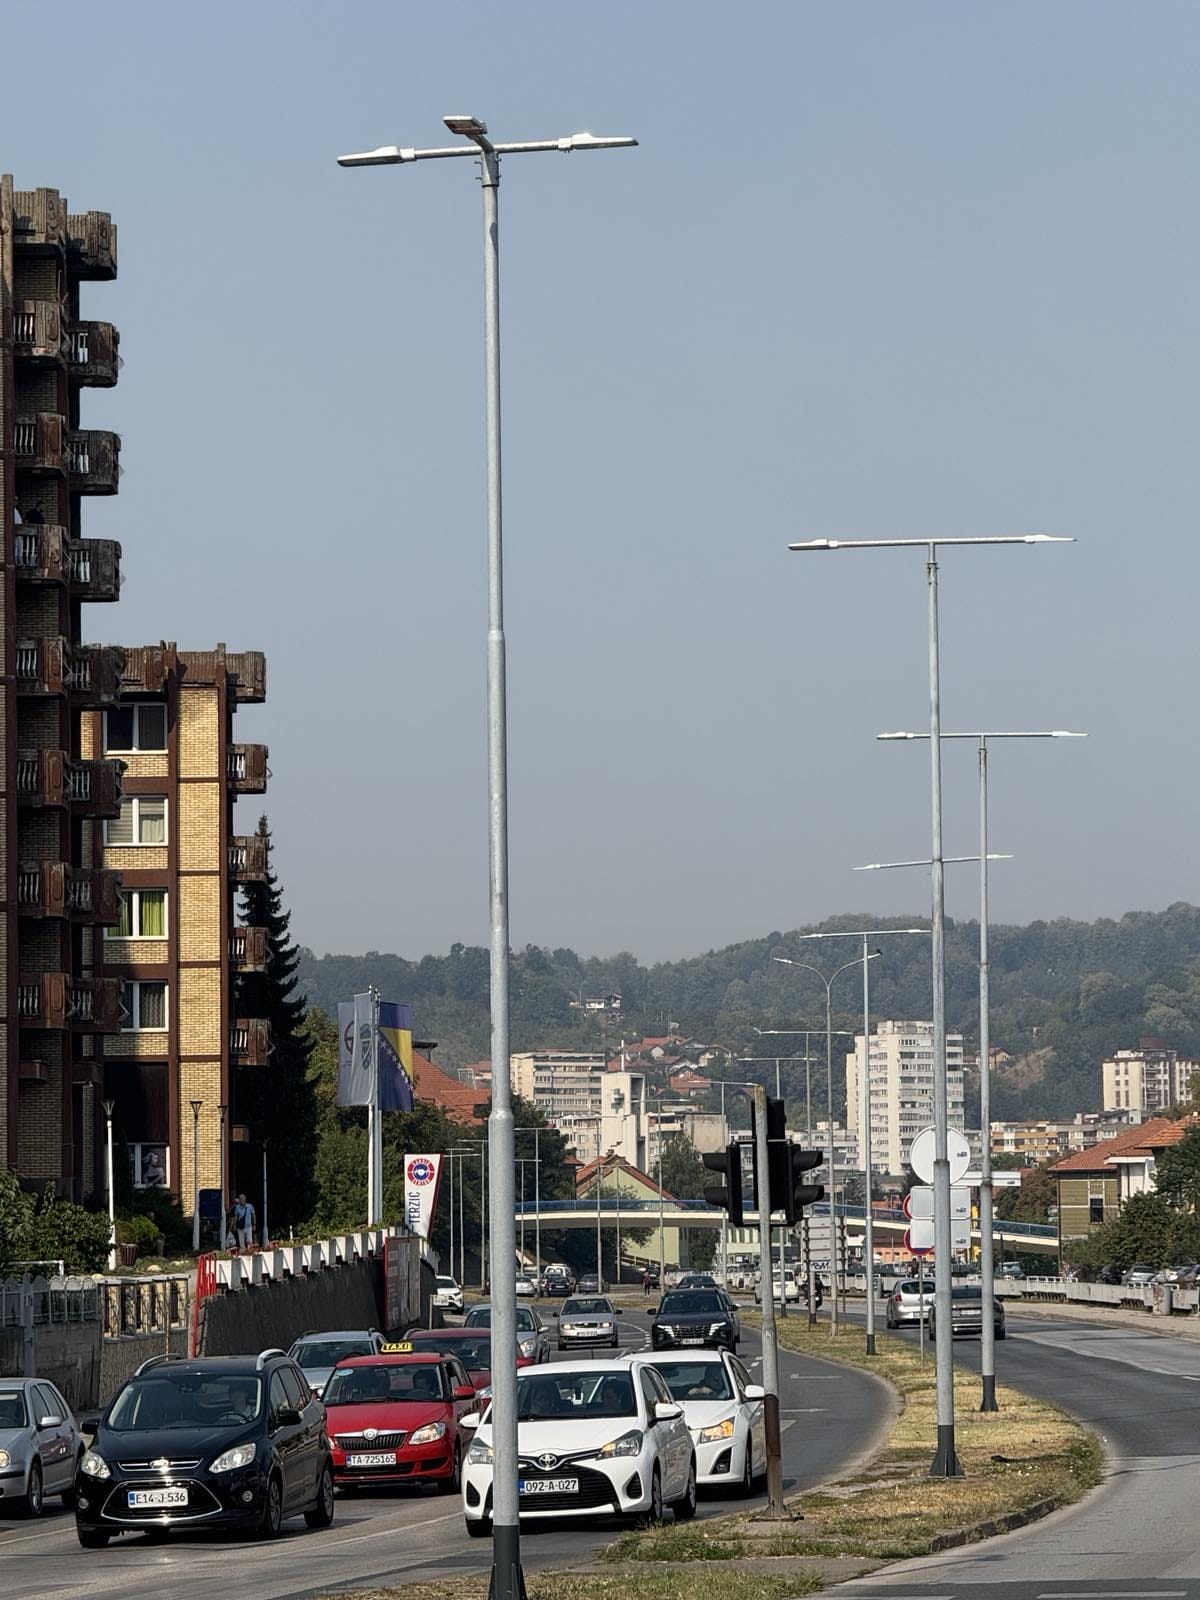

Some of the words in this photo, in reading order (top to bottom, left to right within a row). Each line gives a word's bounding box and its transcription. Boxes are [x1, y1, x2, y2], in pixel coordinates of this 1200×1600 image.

[383, 1343, 410, 1351] TAXI
[352, 1455, 396, 1465] TA-725165
[526, 1480, 577, 1491] 092-A-027
